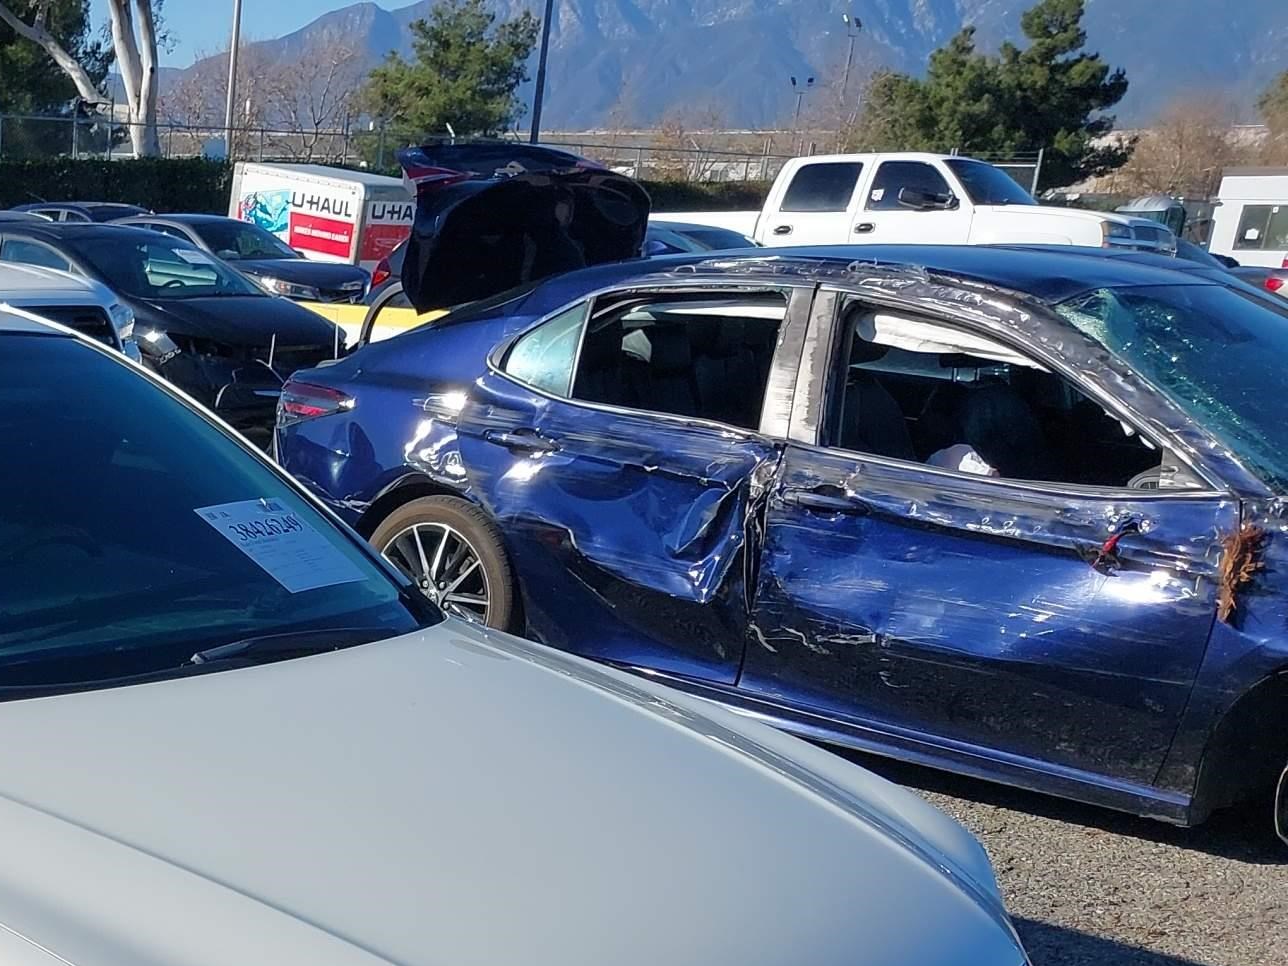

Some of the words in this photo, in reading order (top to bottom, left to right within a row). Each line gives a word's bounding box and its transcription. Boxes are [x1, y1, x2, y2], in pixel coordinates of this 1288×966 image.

[291, 191, 352, 218] U-HAUL
[371, 203, 414, 221] U-HA
[228, 514, 303, 540] 38426249
